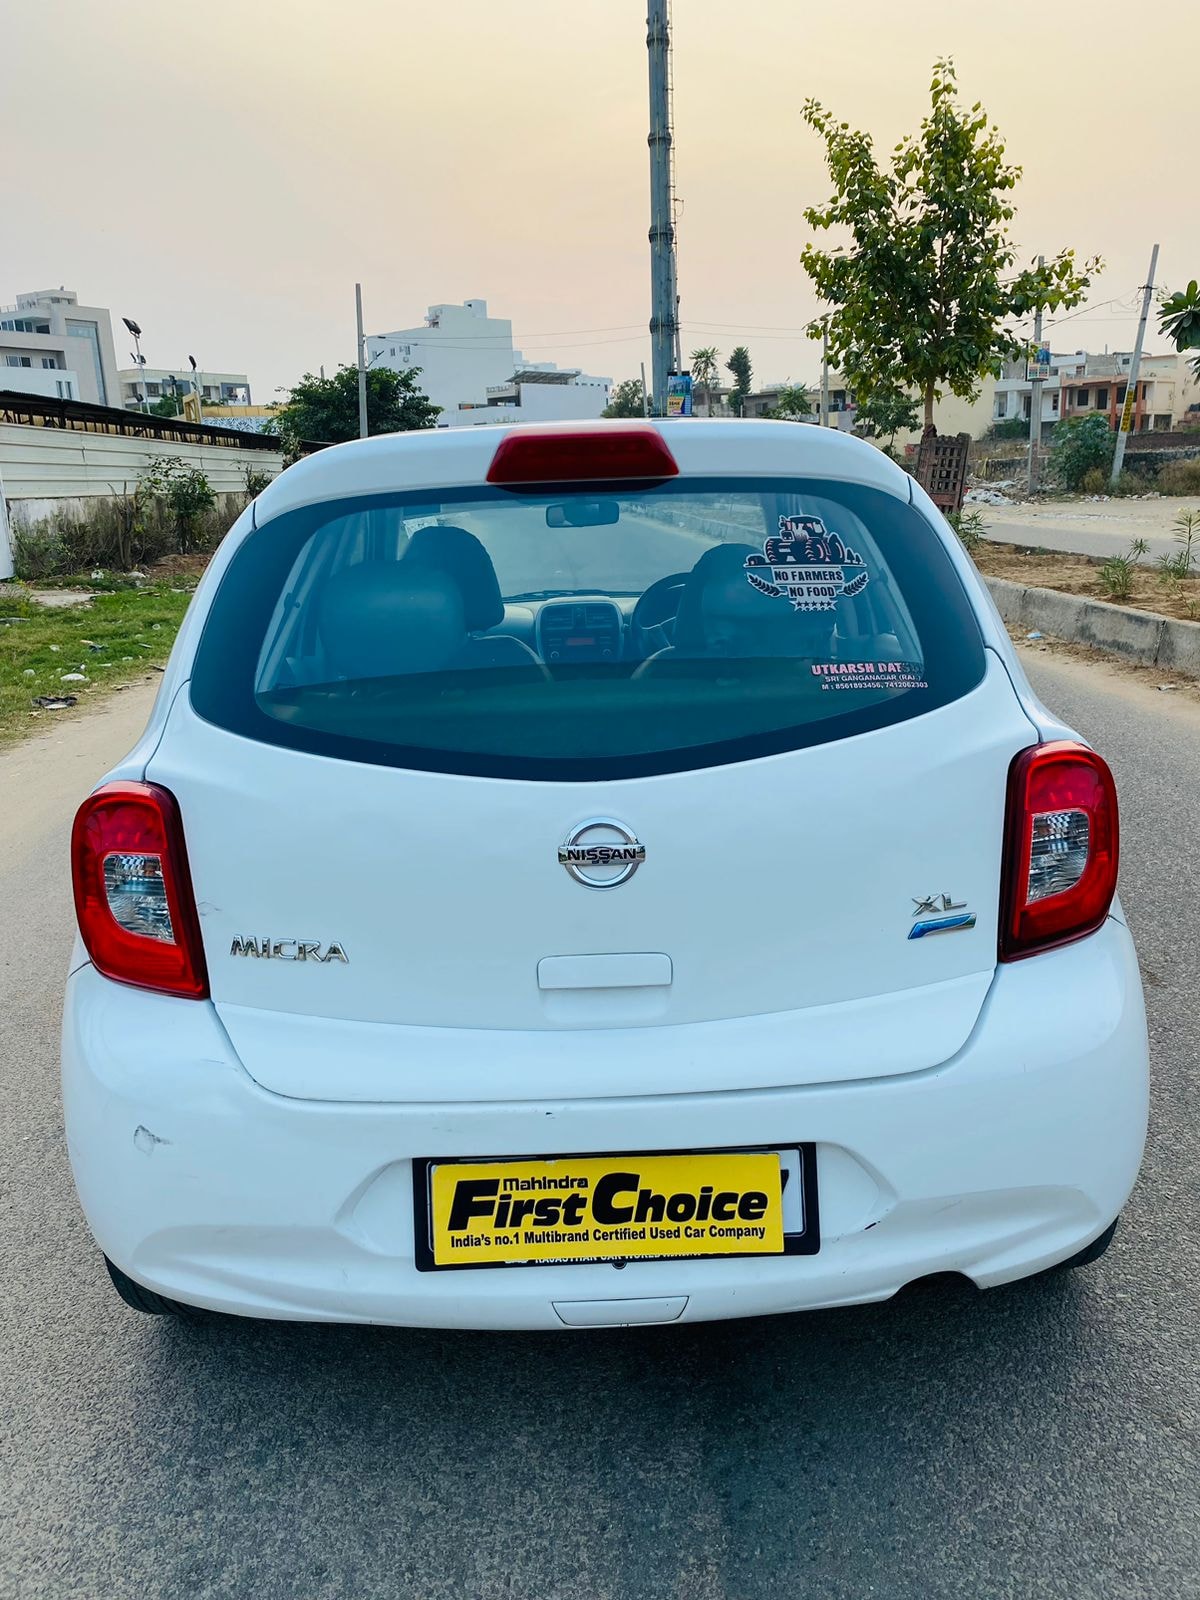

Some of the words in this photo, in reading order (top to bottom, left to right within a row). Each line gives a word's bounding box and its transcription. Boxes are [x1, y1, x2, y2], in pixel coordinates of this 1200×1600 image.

[774, 570, 789, 581] NO
[791, 570, 843, 581] FARMERS
[789, 587, 804, 597] NO
[807, 586, 835, 597] FOOD
[811, 662, 875, 675] UTKARSH
[841, 674, 897, 682] GANGANAGAR
[567, 848, 637, 860] NISSAN
[911, 892, 968, 917] XL
[230, 934, 349, 963] MICRA
[503, 1175, 589, 1191] Mahindra
[448, 1179, 588, 1231] First
[592, 1172, 768, 1225] Choice
[451, 1233, 491, 1248] India's
[494, 1232, 520, 1245] no.1
[524, 1229, 589, 1244] Multibrand
[593, 1227, 646, 1241] Certified
[650, 1226, 680, 1239] Used
[684, 1225, 706, 1238] Car
[709, 1225, 766, 1240] Company
